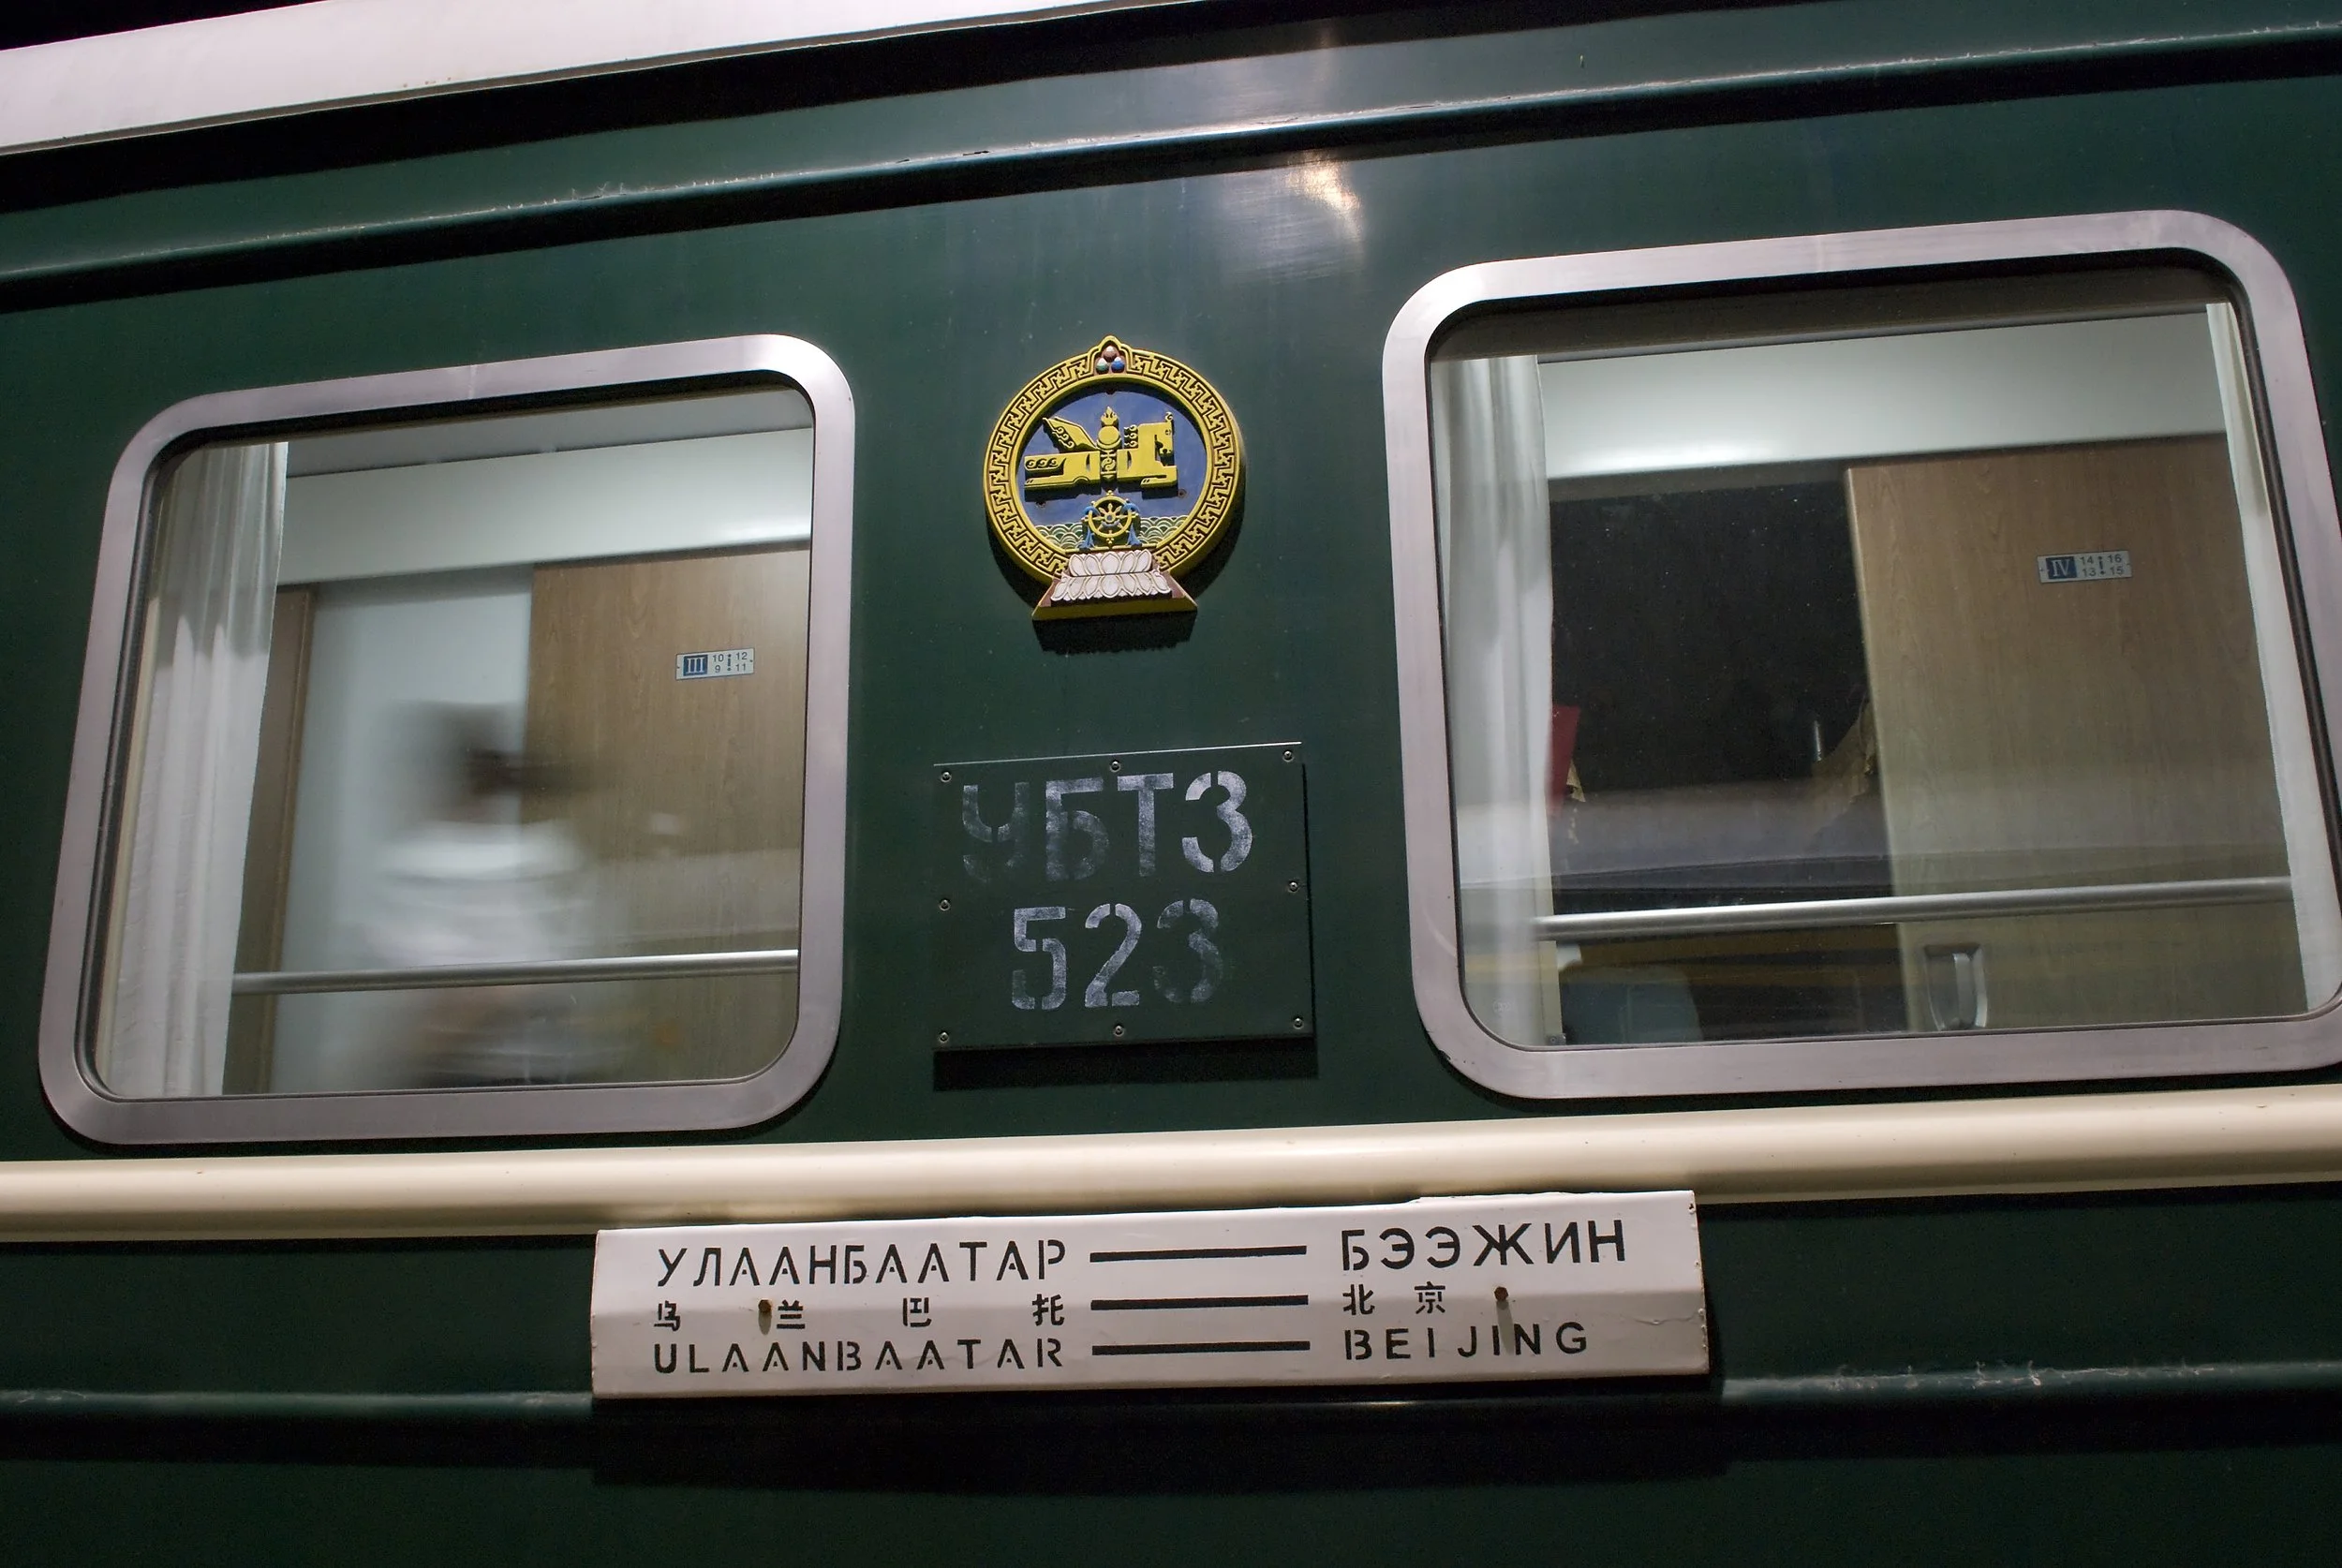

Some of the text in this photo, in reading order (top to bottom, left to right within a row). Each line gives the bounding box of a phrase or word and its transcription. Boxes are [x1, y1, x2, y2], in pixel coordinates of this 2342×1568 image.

[2080, 554, 2122, 566] 14 16
[2083, 566, 2124, 577] 13 15
[712, 651, 748, 662] 10 12
[715, 663, 747, 673] 9 11
[1012, 897, 1223, 1010] 523
[657, 1220, 1625, 1287] УЛААНБААТАР БЭЭЖИН
[1342, 1281, 1446, 1315] 北京
[654, 1321, 1588, 1374] ULAANBAATAR BEIJING
